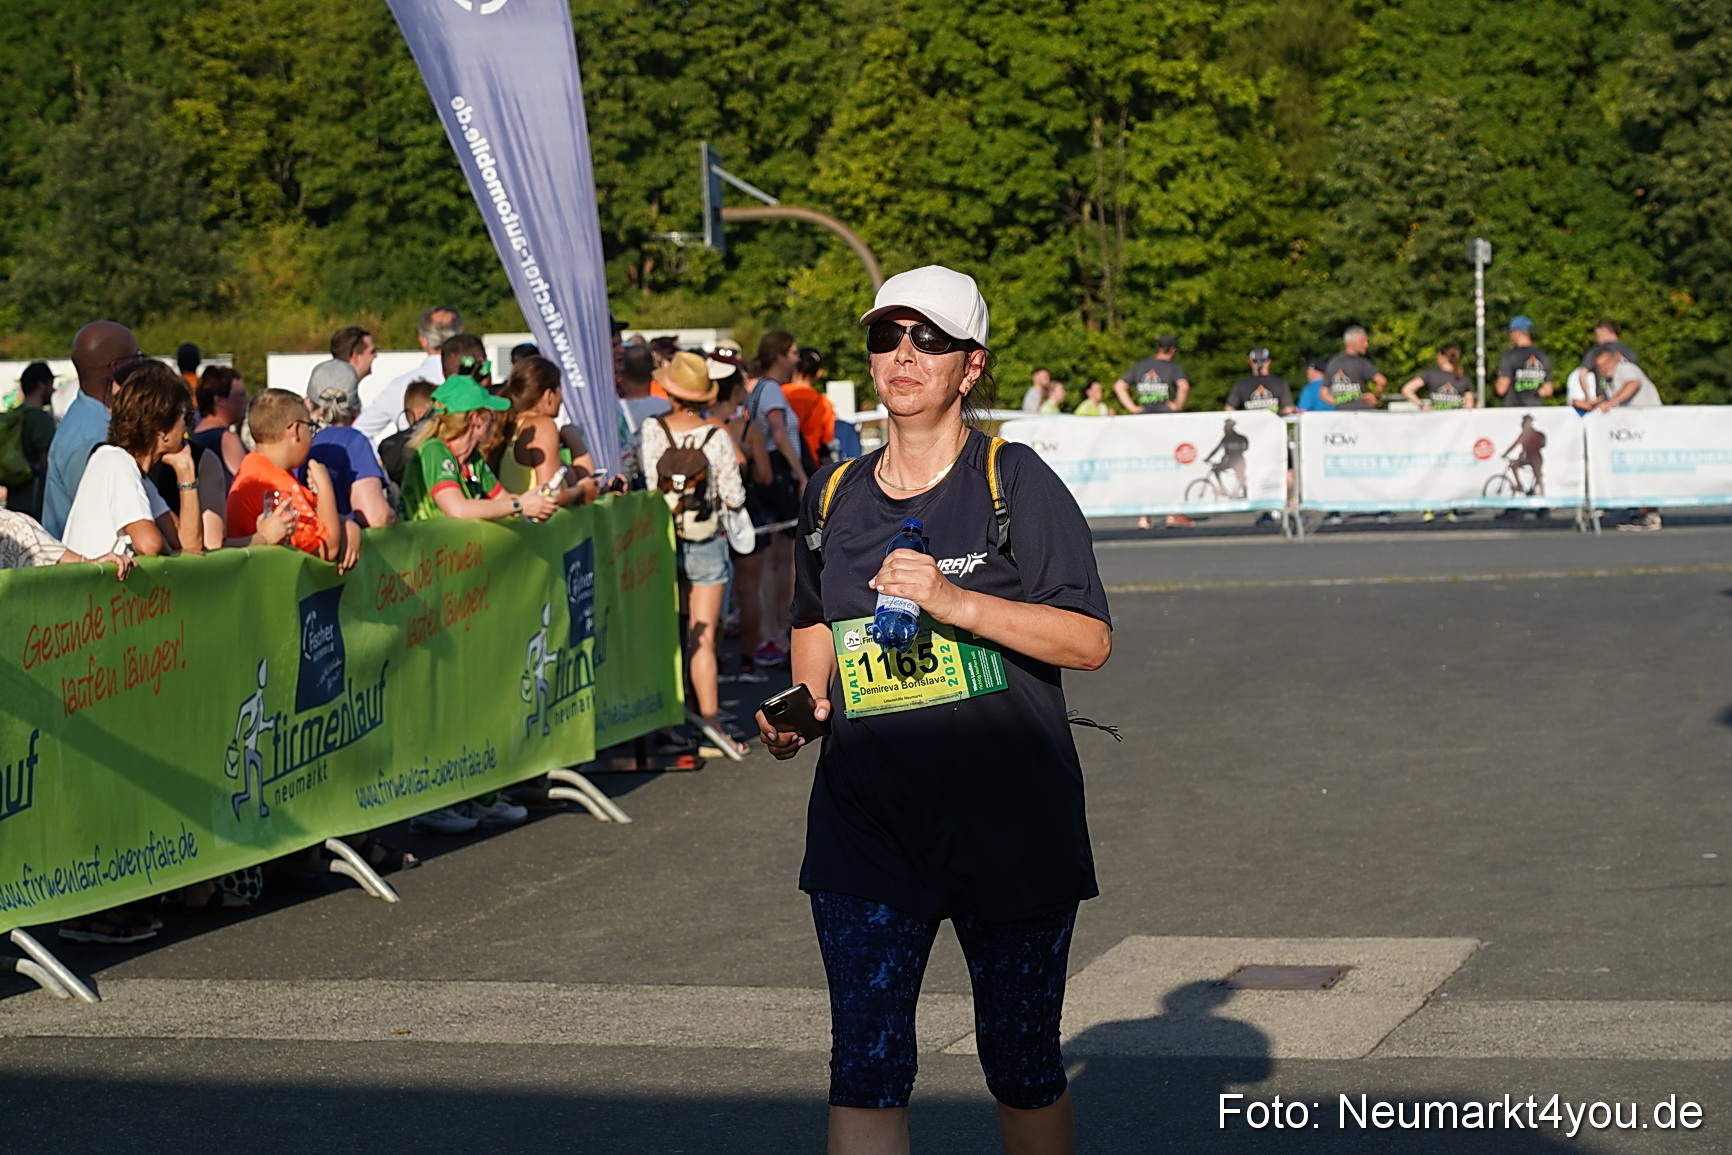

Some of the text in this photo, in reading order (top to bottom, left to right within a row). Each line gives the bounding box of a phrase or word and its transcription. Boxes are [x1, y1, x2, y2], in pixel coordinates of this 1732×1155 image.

[109, 585, 173, 635] Firmen
[845, 658, 861, 704] WALK
[858, 642, 939, 683] 1165
[940, 643, 959, 687] 2022
[860, 675, 946, 696] Demireva Borislava
[268, 658, 390, 782] firmenlauf
[274, 762, 329, 807] neumarkt
[0, 822, 198, 912] ww.firmenlauf-oberpfalz.de
